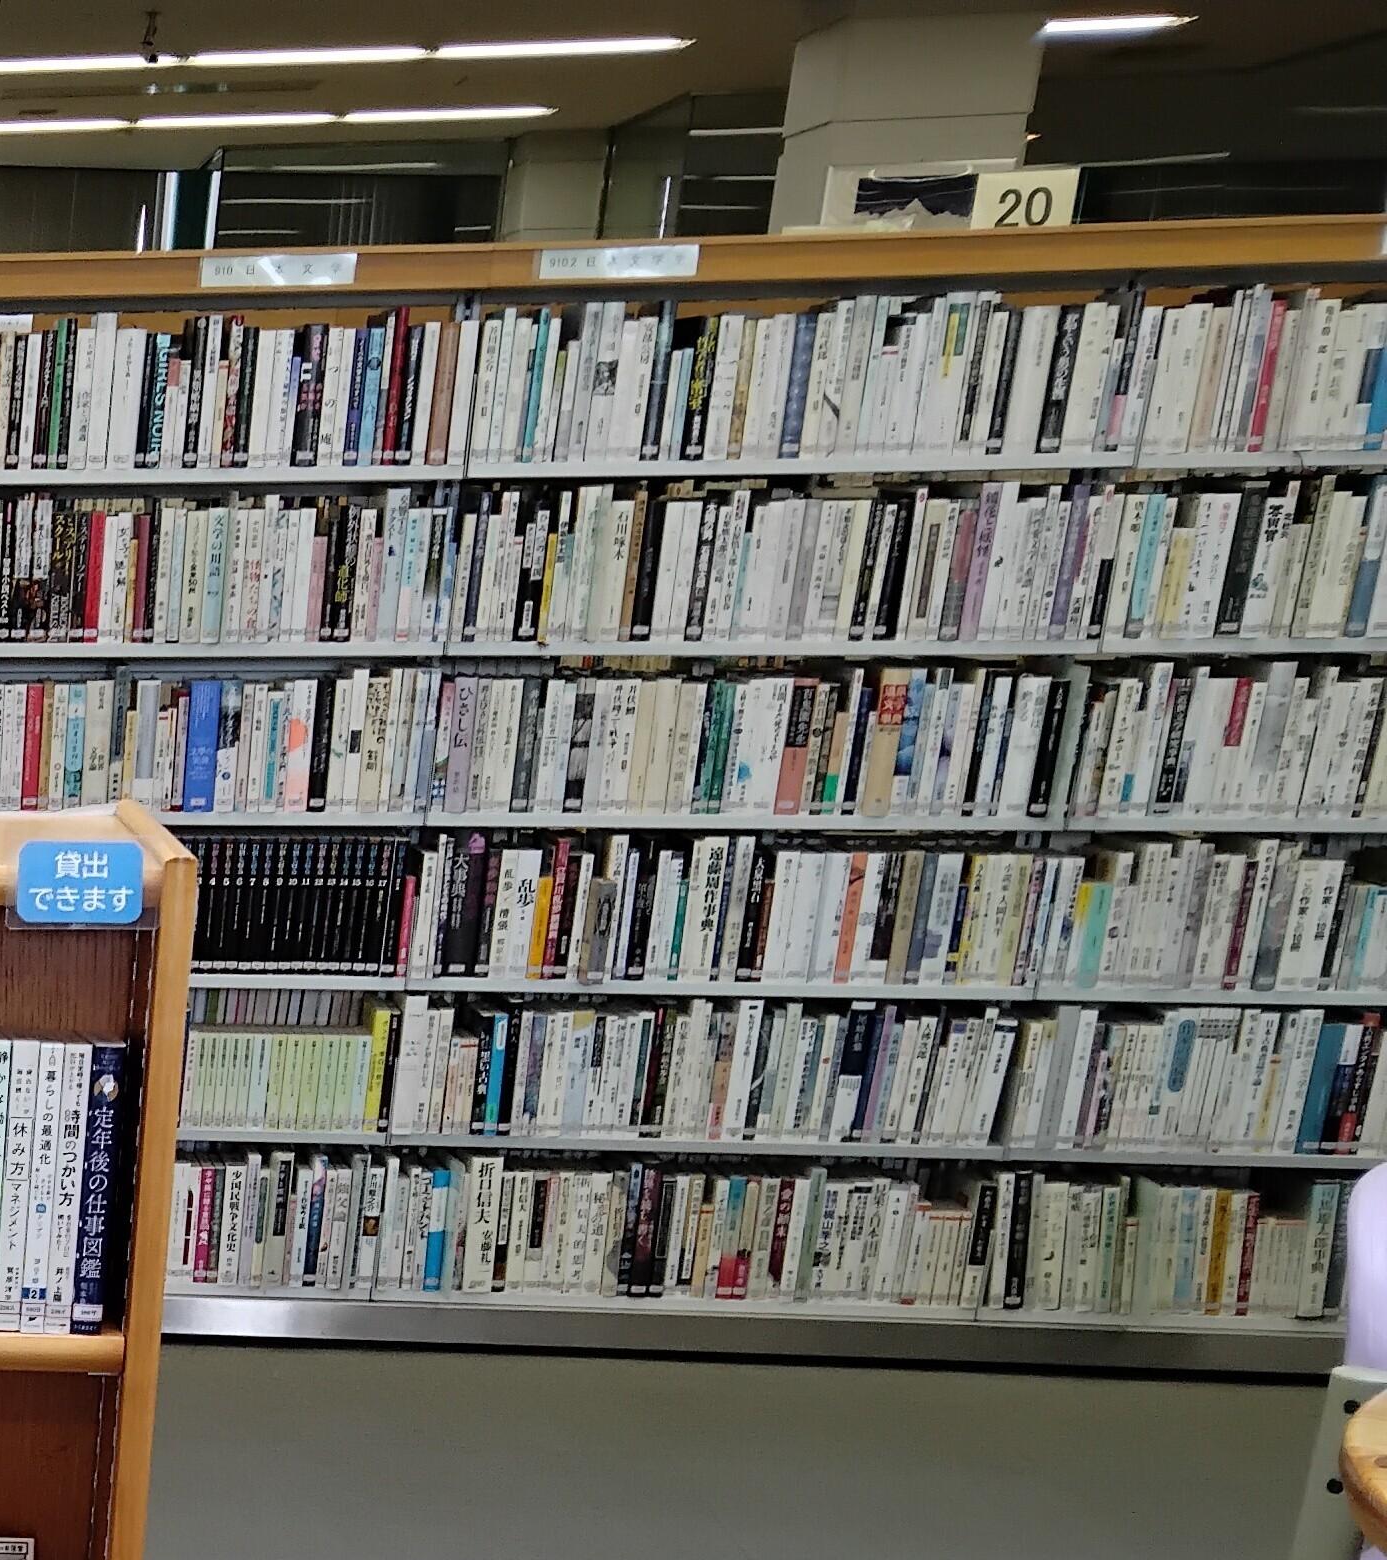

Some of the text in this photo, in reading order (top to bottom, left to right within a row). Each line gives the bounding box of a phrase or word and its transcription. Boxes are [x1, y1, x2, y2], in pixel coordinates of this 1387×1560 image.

[994, 186, 1054, 227] 20
[214, 262, 343, 276] 910 日本文学
[613, 510, 629, 561] 石川啄木
[54, 849, 109, 880] 貸出
[249, 877, 257, 887] 7
[288, 877, 298, 887] 10
[301, 877, 311, 887] 11
[339, 877, 349, 887] 14
[377, 877, 388, 887] 17
[28, 885, 136, 912] できます
[699, 846, 724, 933] 遠藤周作事典
[38, 1069, 58, 1166] 暮らしの最適化
[10, 1122, 29, 1177] 休み方
[79, 1105, 116, 1279] 定年後の仕事図鑑
[474, 1161, 496, 1225] 折口信夫
[7, 1182, 23, 1251] マネジメント
[225, 1170, 243, 1253] 少国民戦争文化史
[30, 1289, 38, 1300] 2
